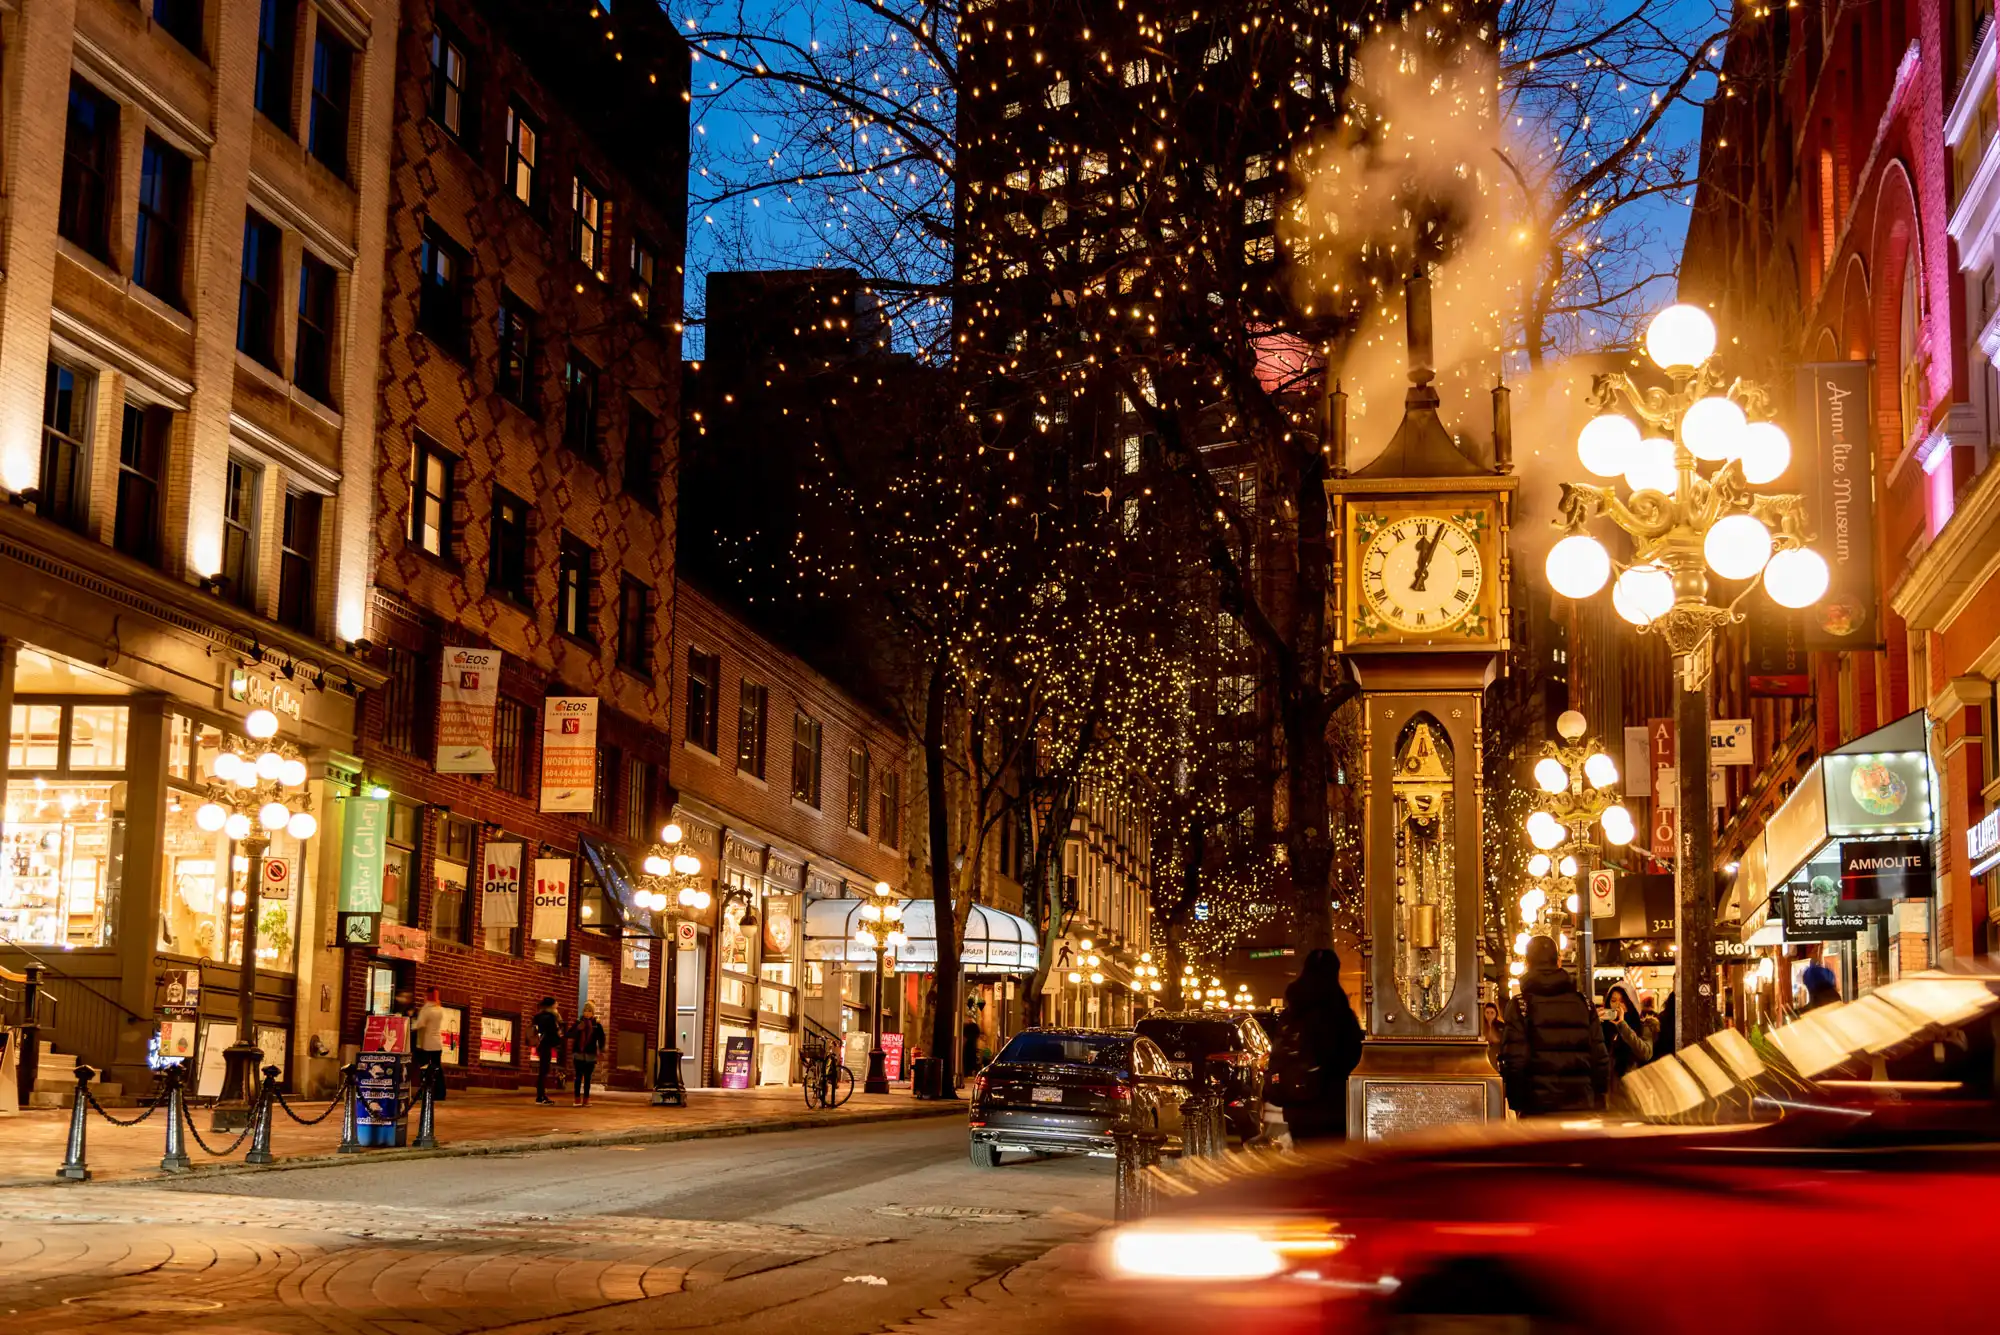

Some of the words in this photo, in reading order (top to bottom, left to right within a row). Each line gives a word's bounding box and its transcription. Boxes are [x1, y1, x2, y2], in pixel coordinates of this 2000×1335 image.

[1832, 478, 1852, 565] Museum
[454, 651, 489, 665] GEOS
[248, 676, 271, 705] Silver
[555, 700, 588, 712] GEOS
[352, 803, 380, 858] Gallery
[1849, 856, 1922, 871] AMMOLITE
[350, 864, 371, 906] Silver
[485, 882, 518, 893] OHC
[535, 896, 566, 907] OHC
[1652, 919, 1673, 932] 321
[1826, 918, 1863, 926] Bem-Vindo
[882, 1034, 904, 1042] MENU
